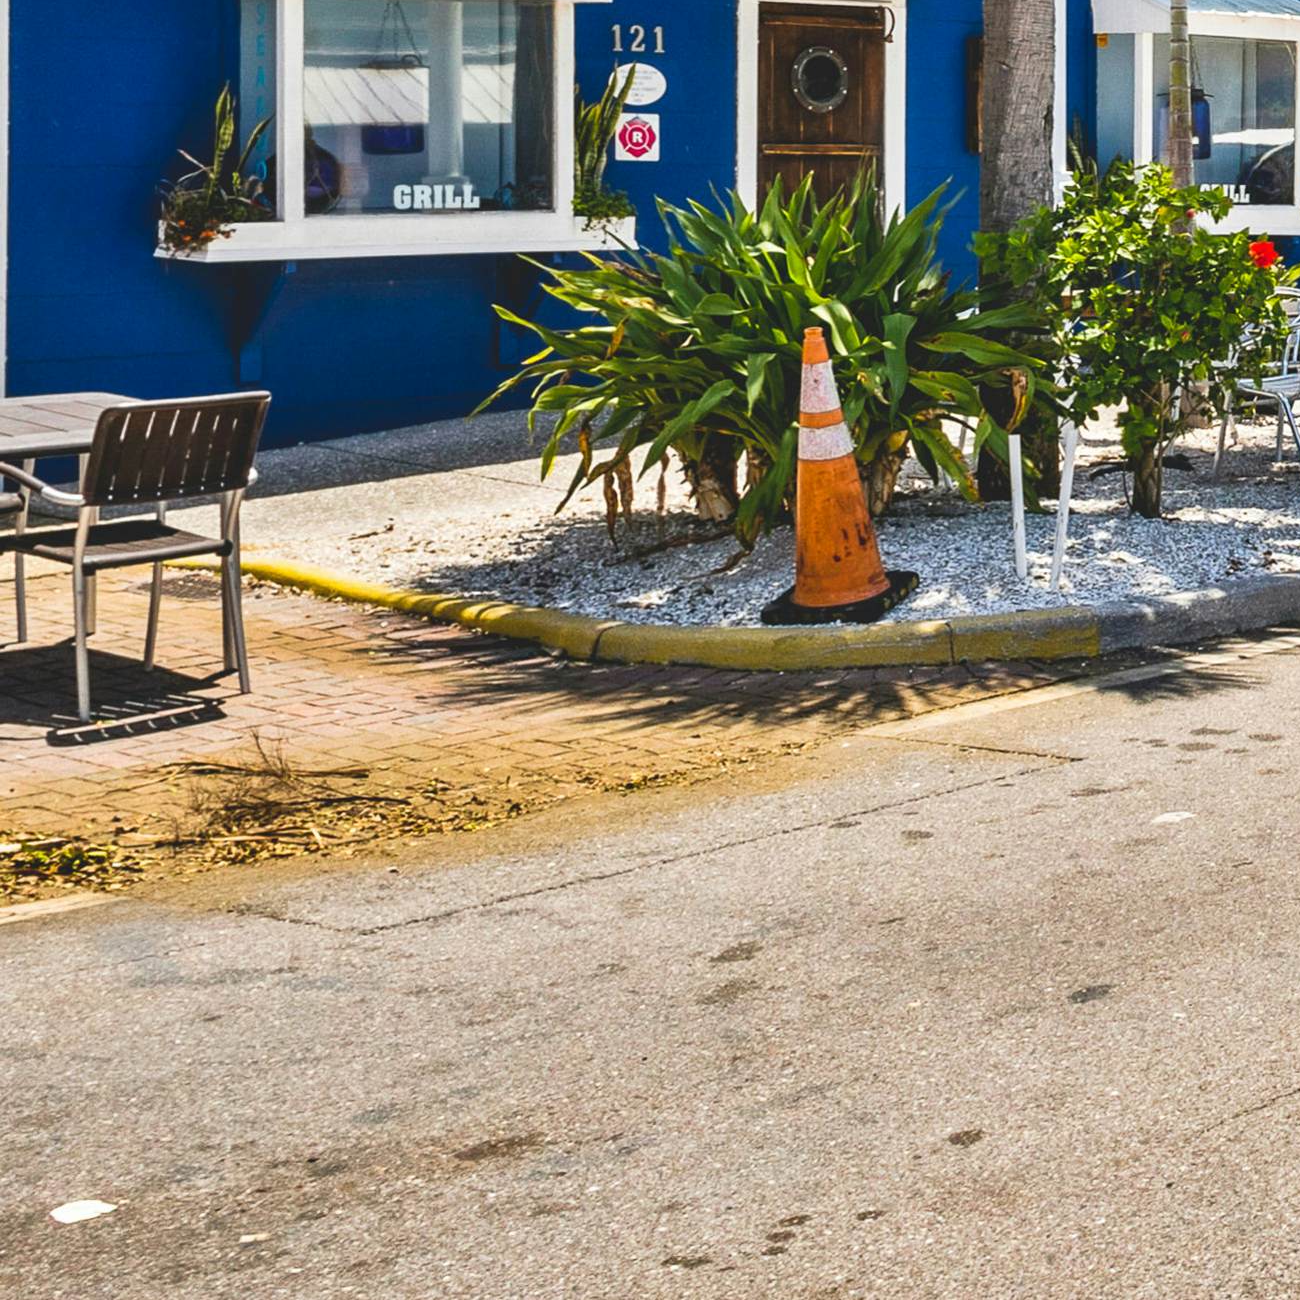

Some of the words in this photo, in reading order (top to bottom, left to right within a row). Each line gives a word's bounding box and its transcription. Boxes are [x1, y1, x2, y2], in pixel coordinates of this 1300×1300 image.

[611, 24, 666, 53] 121
[631, 131, 643, 143] R
[393, 184, 480, 209] GRILL
